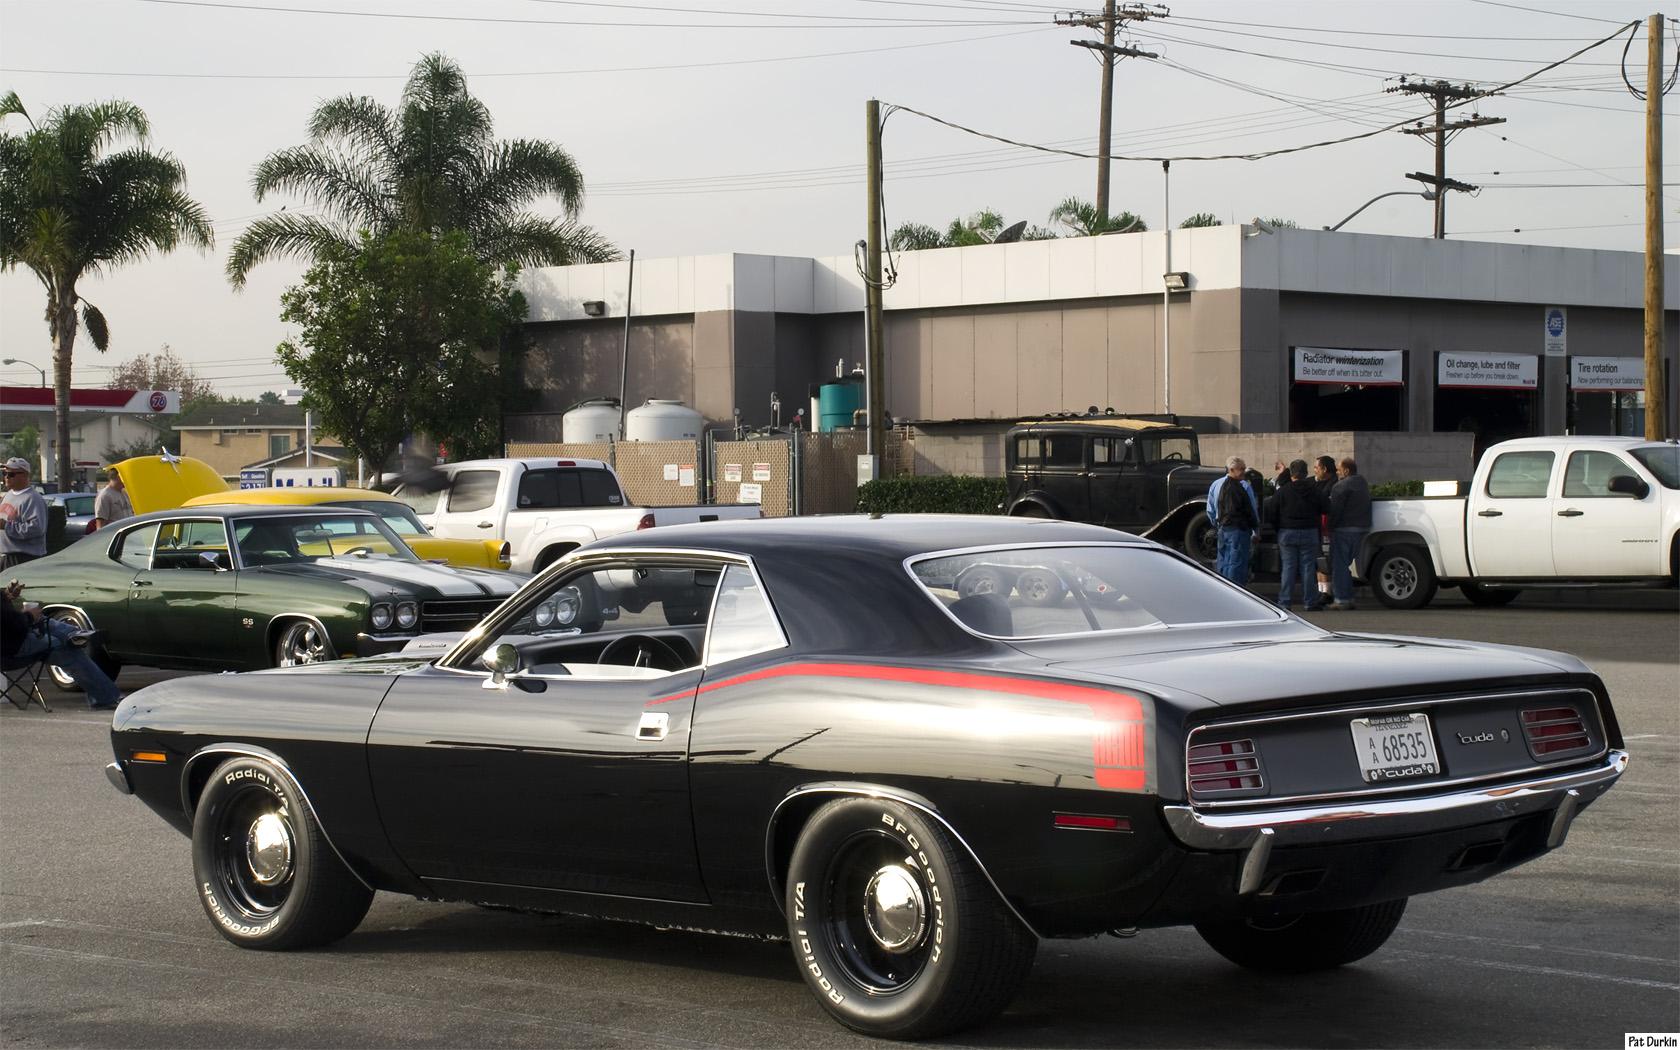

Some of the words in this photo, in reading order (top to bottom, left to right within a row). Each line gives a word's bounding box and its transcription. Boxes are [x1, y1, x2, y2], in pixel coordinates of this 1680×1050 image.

[1303, 353, 1335, 364] Radiator
[1335, 355, 1384, 366] winterization
[1446, 359, 1455, 368] Oil
[1456, 360, 1480, 370] change,
[1480, 360, 1494, 369] lube
[1494, 361, 1506, 370] and
[1507, 361, 1520, 370] filter
[1578, 362, 1591, 373] Tire
[1592, 363, 1618, 373] rotation
[1302, 367, 1311, 375] Be
[1311, 368, 1327, 376] better
[1328, 368, 1336, 376] off
[1336, 368, 1351, 377] when
[1359, 369, 1373, 377] bitter
[1577, 376, 1588, 384] Now
[1589, 376, 1613, 385] performing
[242, 617, 254, 625] SS
[1382, 732, 1427, 762] 68535
[225, 768, 270, 785] Radial
[273, 784, 289, 808] T/A
[881, 813, 945, 963] BFGoodrich
[204, 882, 280, 935] BFGoodrich
[795, 882, 806, 920] T/A
[798, 930, 845, 1005] Radial
